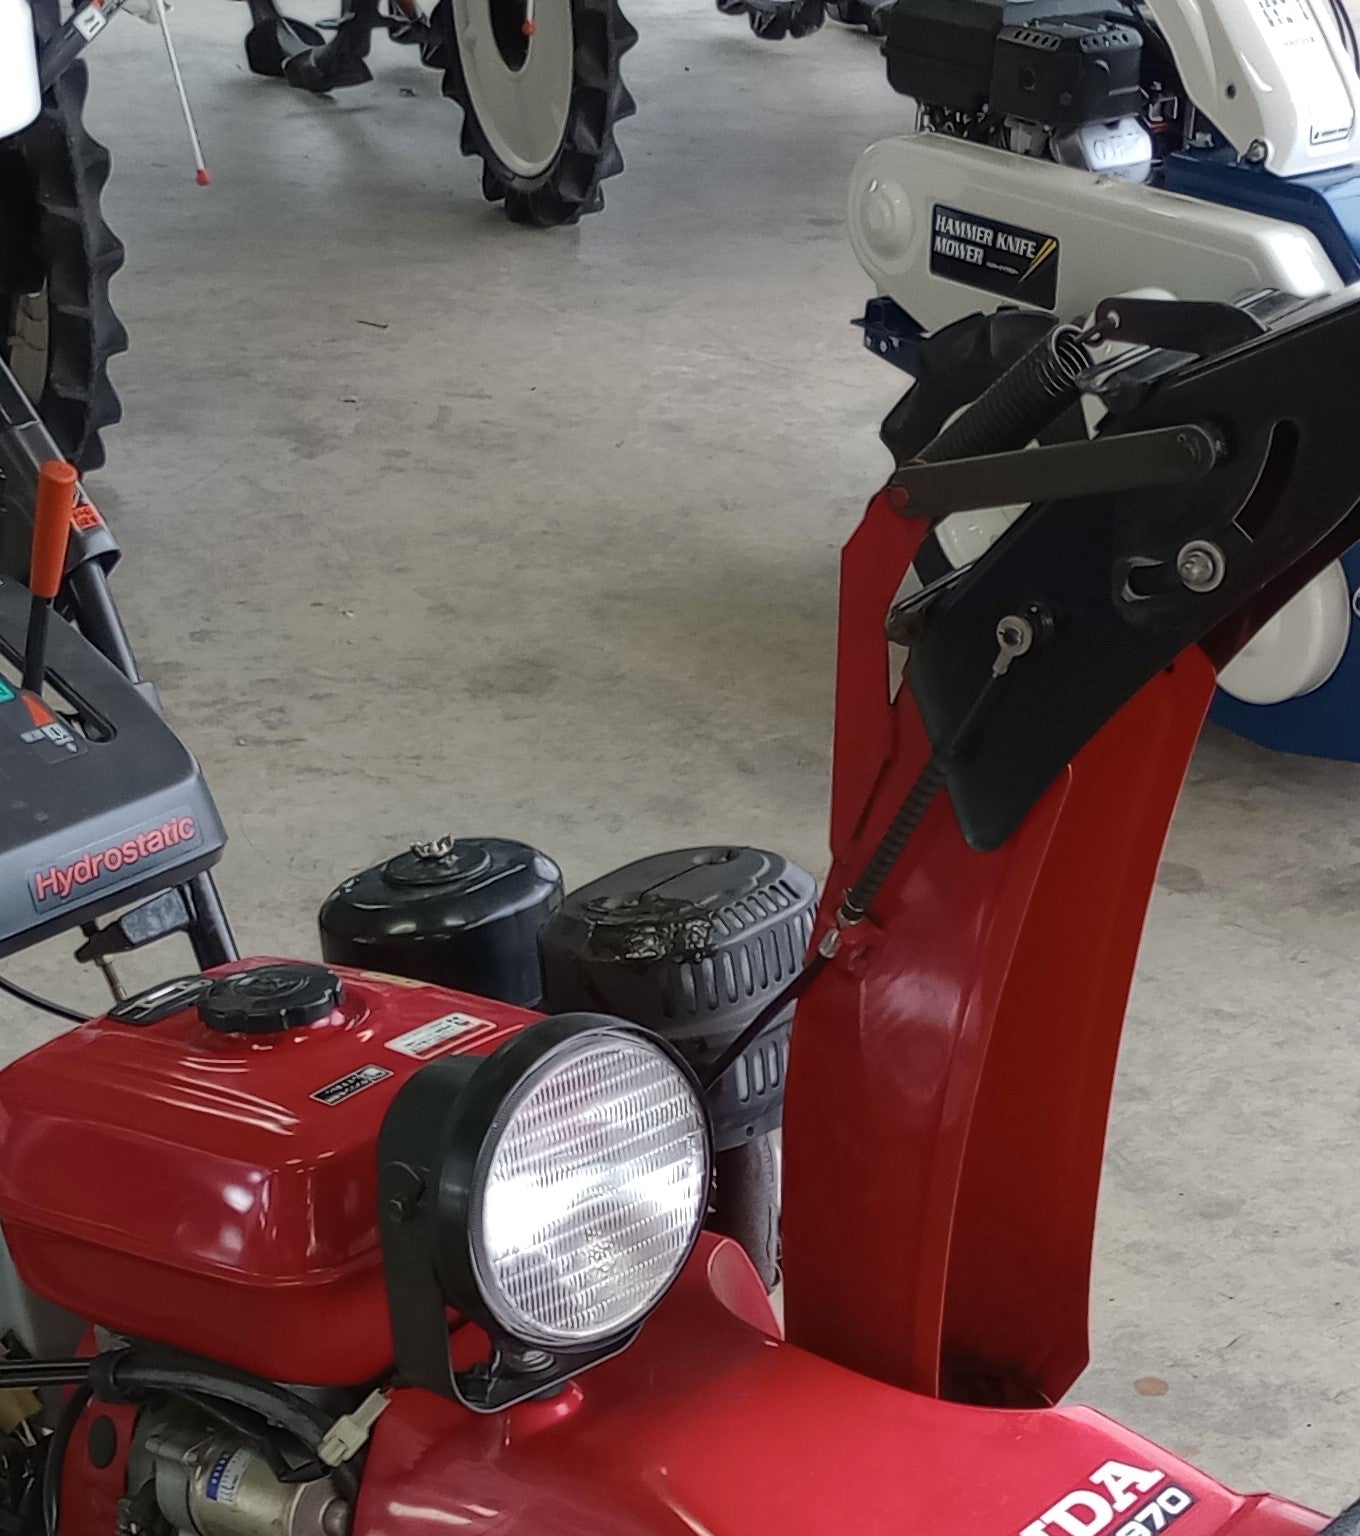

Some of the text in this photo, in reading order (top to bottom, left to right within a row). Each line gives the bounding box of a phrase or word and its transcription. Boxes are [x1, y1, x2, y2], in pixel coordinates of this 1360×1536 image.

[934, 236, 984, 265] MOWER
[936, 214, 1037, 258] HAMMER KNIFE
[34, 815, 196, 901] Hydrostatic
